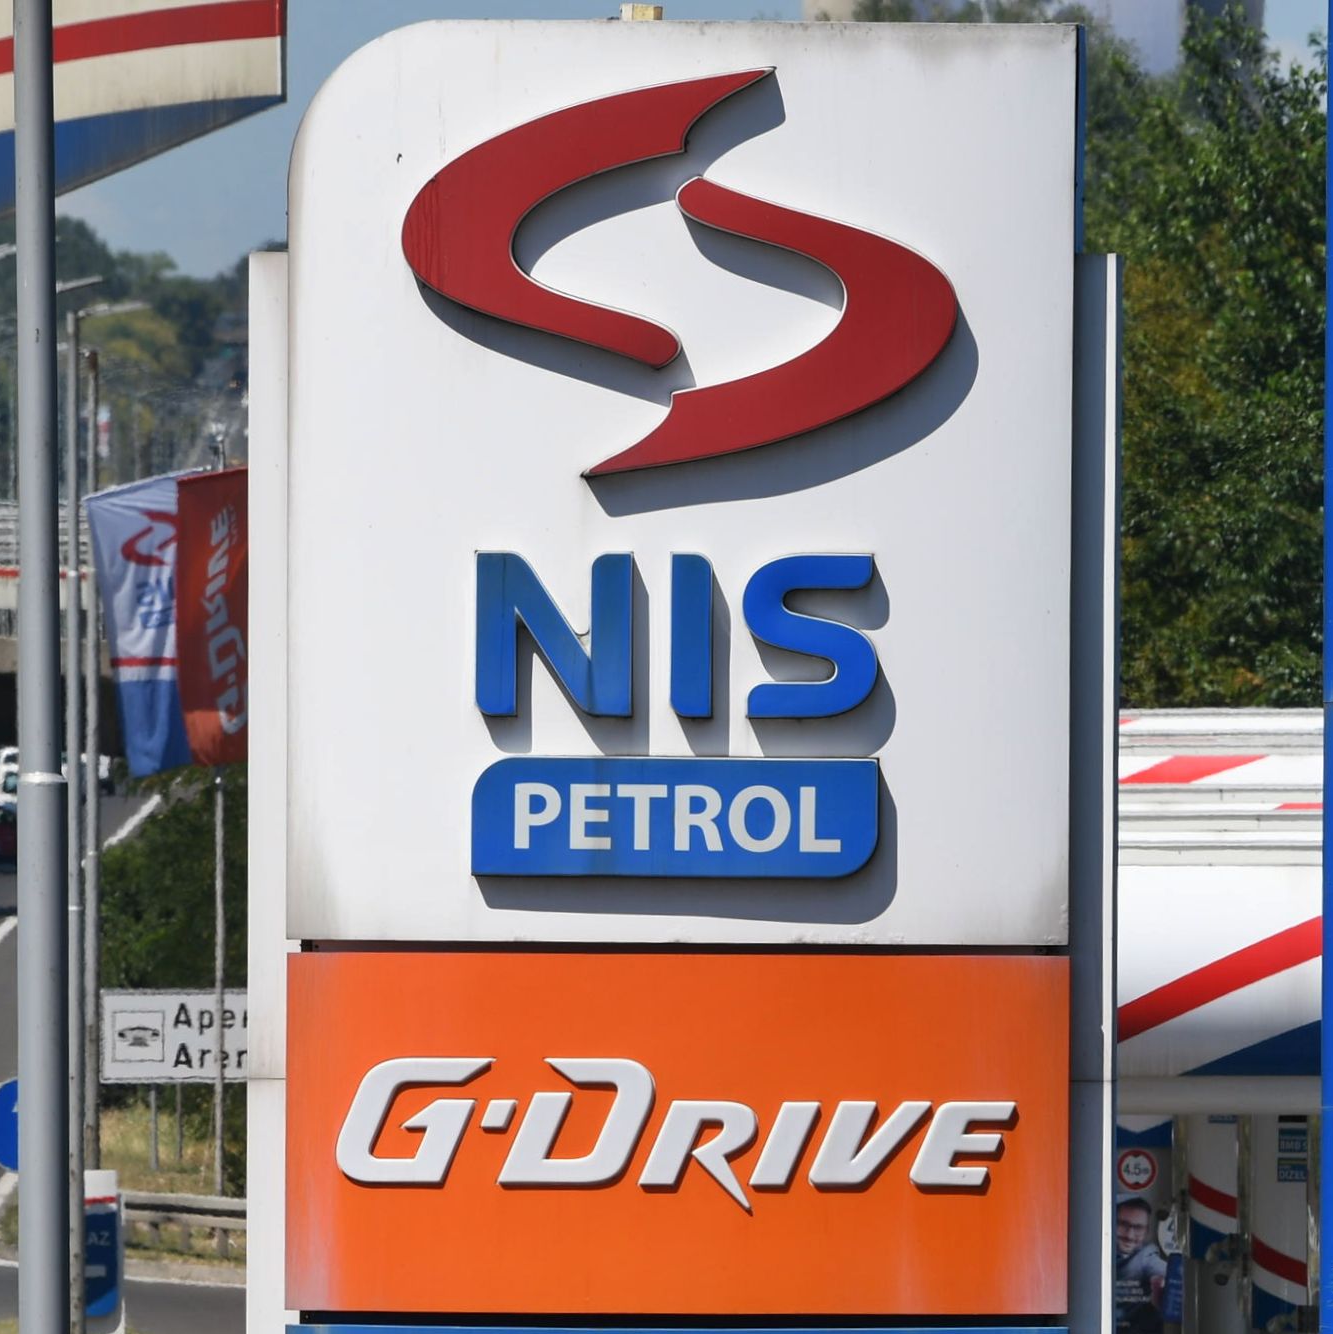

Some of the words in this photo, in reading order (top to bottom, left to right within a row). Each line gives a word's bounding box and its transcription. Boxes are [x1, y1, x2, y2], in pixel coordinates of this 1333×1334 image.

[475, 551, 878, 718] NIS
[513, 783, 841, 853] PETROL
[173, 1002, 248, 1035] Аре
[173, 1042, 248, 1069] Aren
